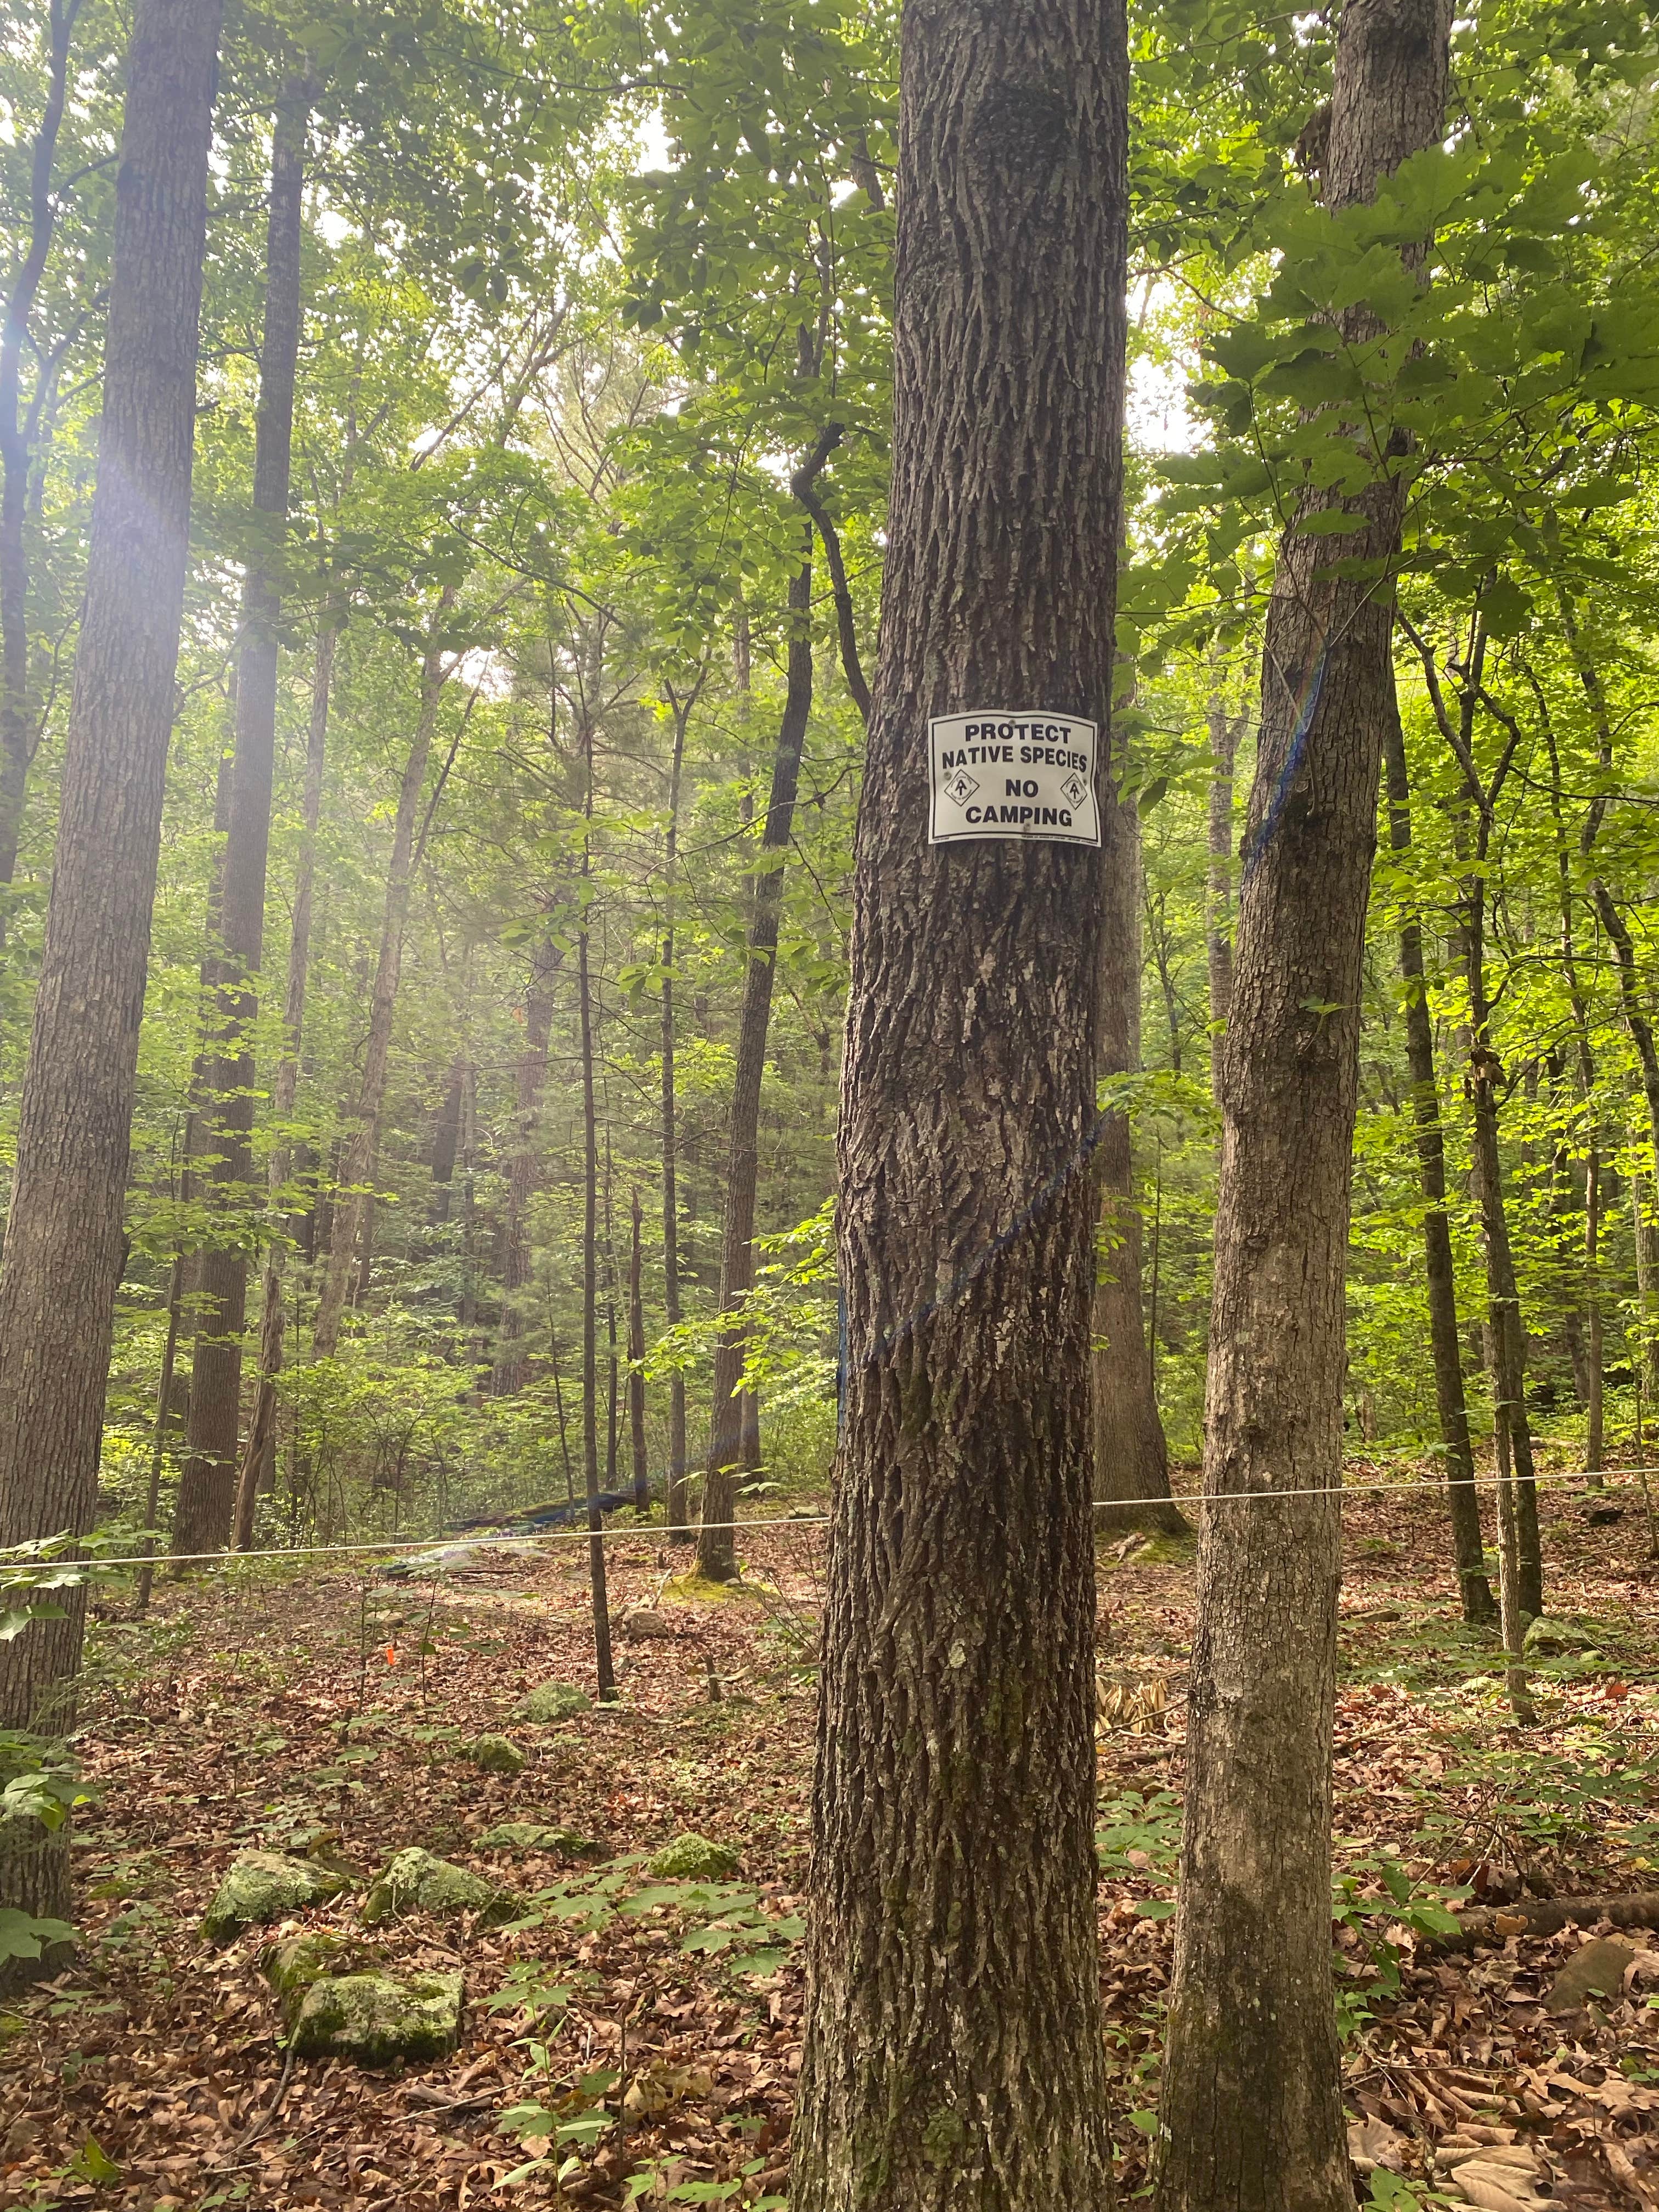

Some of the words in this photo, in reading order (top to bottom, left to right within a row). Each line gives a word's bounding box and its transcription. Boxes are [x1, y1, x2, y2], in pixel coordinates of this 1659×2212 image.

[965, 723, 1071, 744] PROTECT
[941, 746, 1014, 769] NATIVE
[1020, 746, 1087, 773] SPECIES
[1006, 779, 1039, 798] NO
[965, 805, 1072, 827] CAMPING
